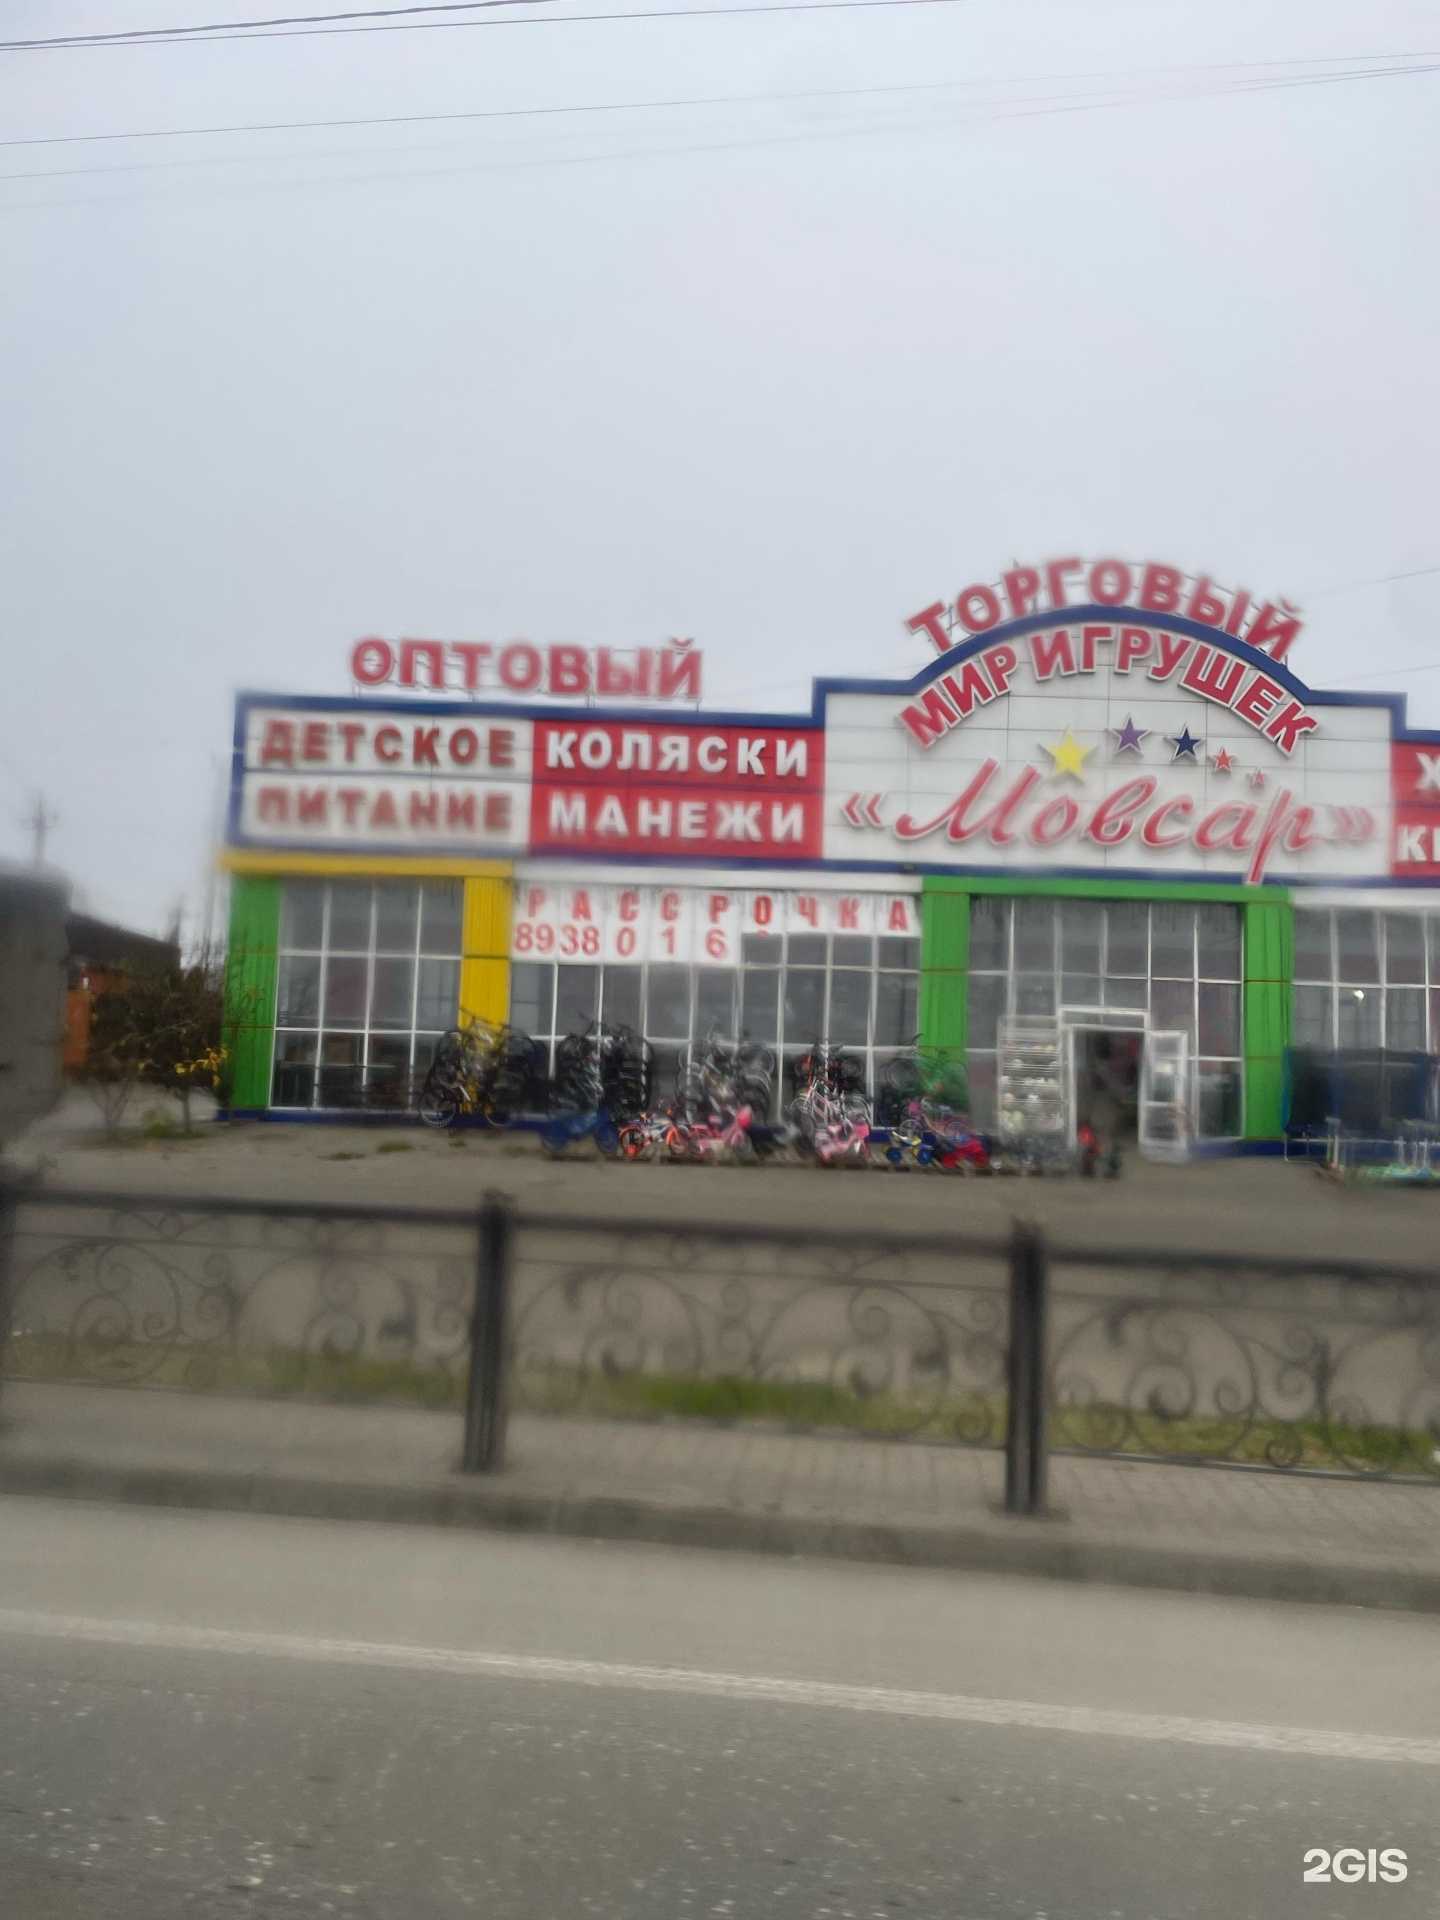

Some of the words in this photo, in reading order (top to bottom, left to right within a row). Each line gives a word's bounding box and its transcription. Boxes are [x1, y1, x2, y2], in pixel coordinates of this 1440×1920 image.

[905, 557, 1304, 661] ТОРГОВЫЙ
[350, 637, 702, 699] ОПТОВЫЙ
[900, 645, 1018, 750] МИР
[1030, 625, 1318, 756] ИГРУШЕК
[261, 720, 515, 767] ДЕТСКОЕ
[546, 730, 808, 778] КОЛЯСКИ
[257, 787, 512, 831] ПИТАНИЕ
[549, 792, 804, 842] МАНЕЖИ
[526, 889, 909, 931] РАССРОЧКА
